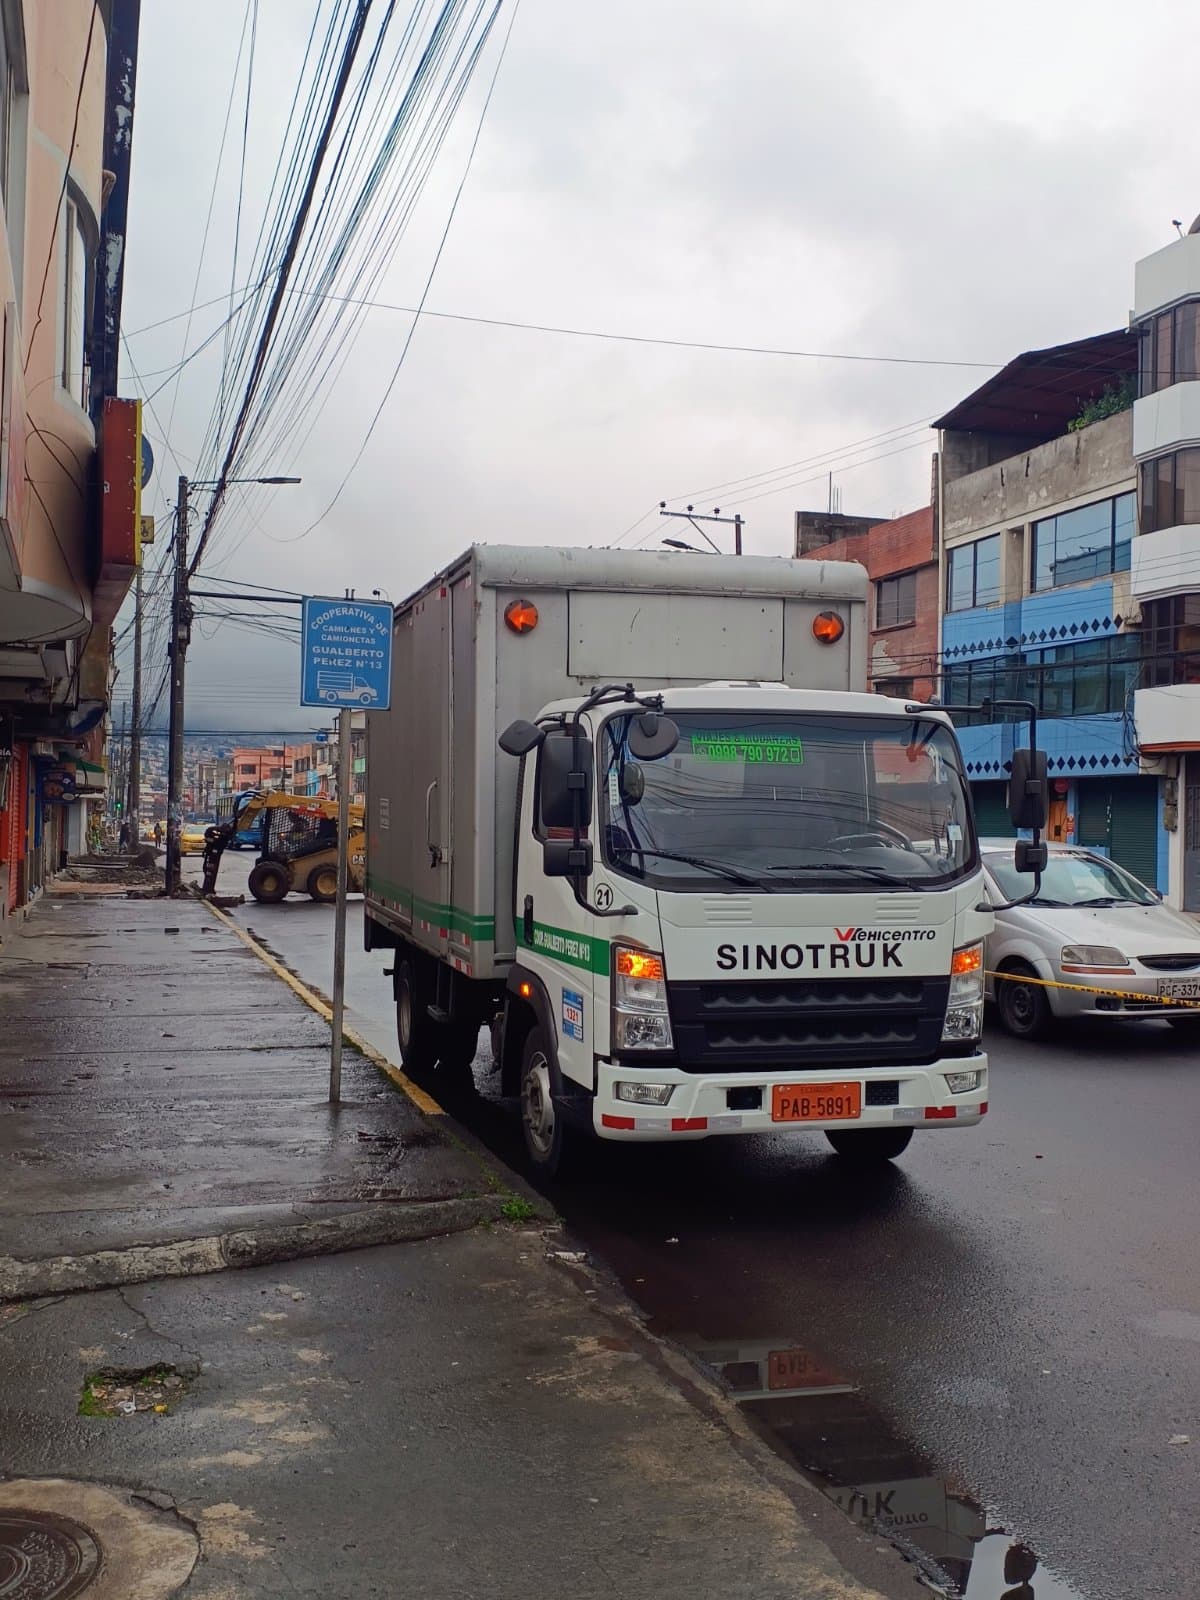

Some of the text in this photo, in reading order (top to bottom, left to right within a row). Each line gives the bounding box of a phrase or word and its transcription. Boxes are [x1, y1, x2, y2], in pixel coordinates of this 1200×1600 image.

[311, 607, 389, 636] COOPERATIVA DE
[321, 634, 376, 645] CAMIONETAS
[312, 646, 384, 658] GUALBERTO
[741, 745, 762, 761] 790
[766, 746, 788, 762] 972
[597, 889, 610, 906] 21
[716, 942, 904, 970] SINOTRUK
[1160, 984, 1200, 997] PCF-337
[781, 1095, 852, 1118] PAB-5891
